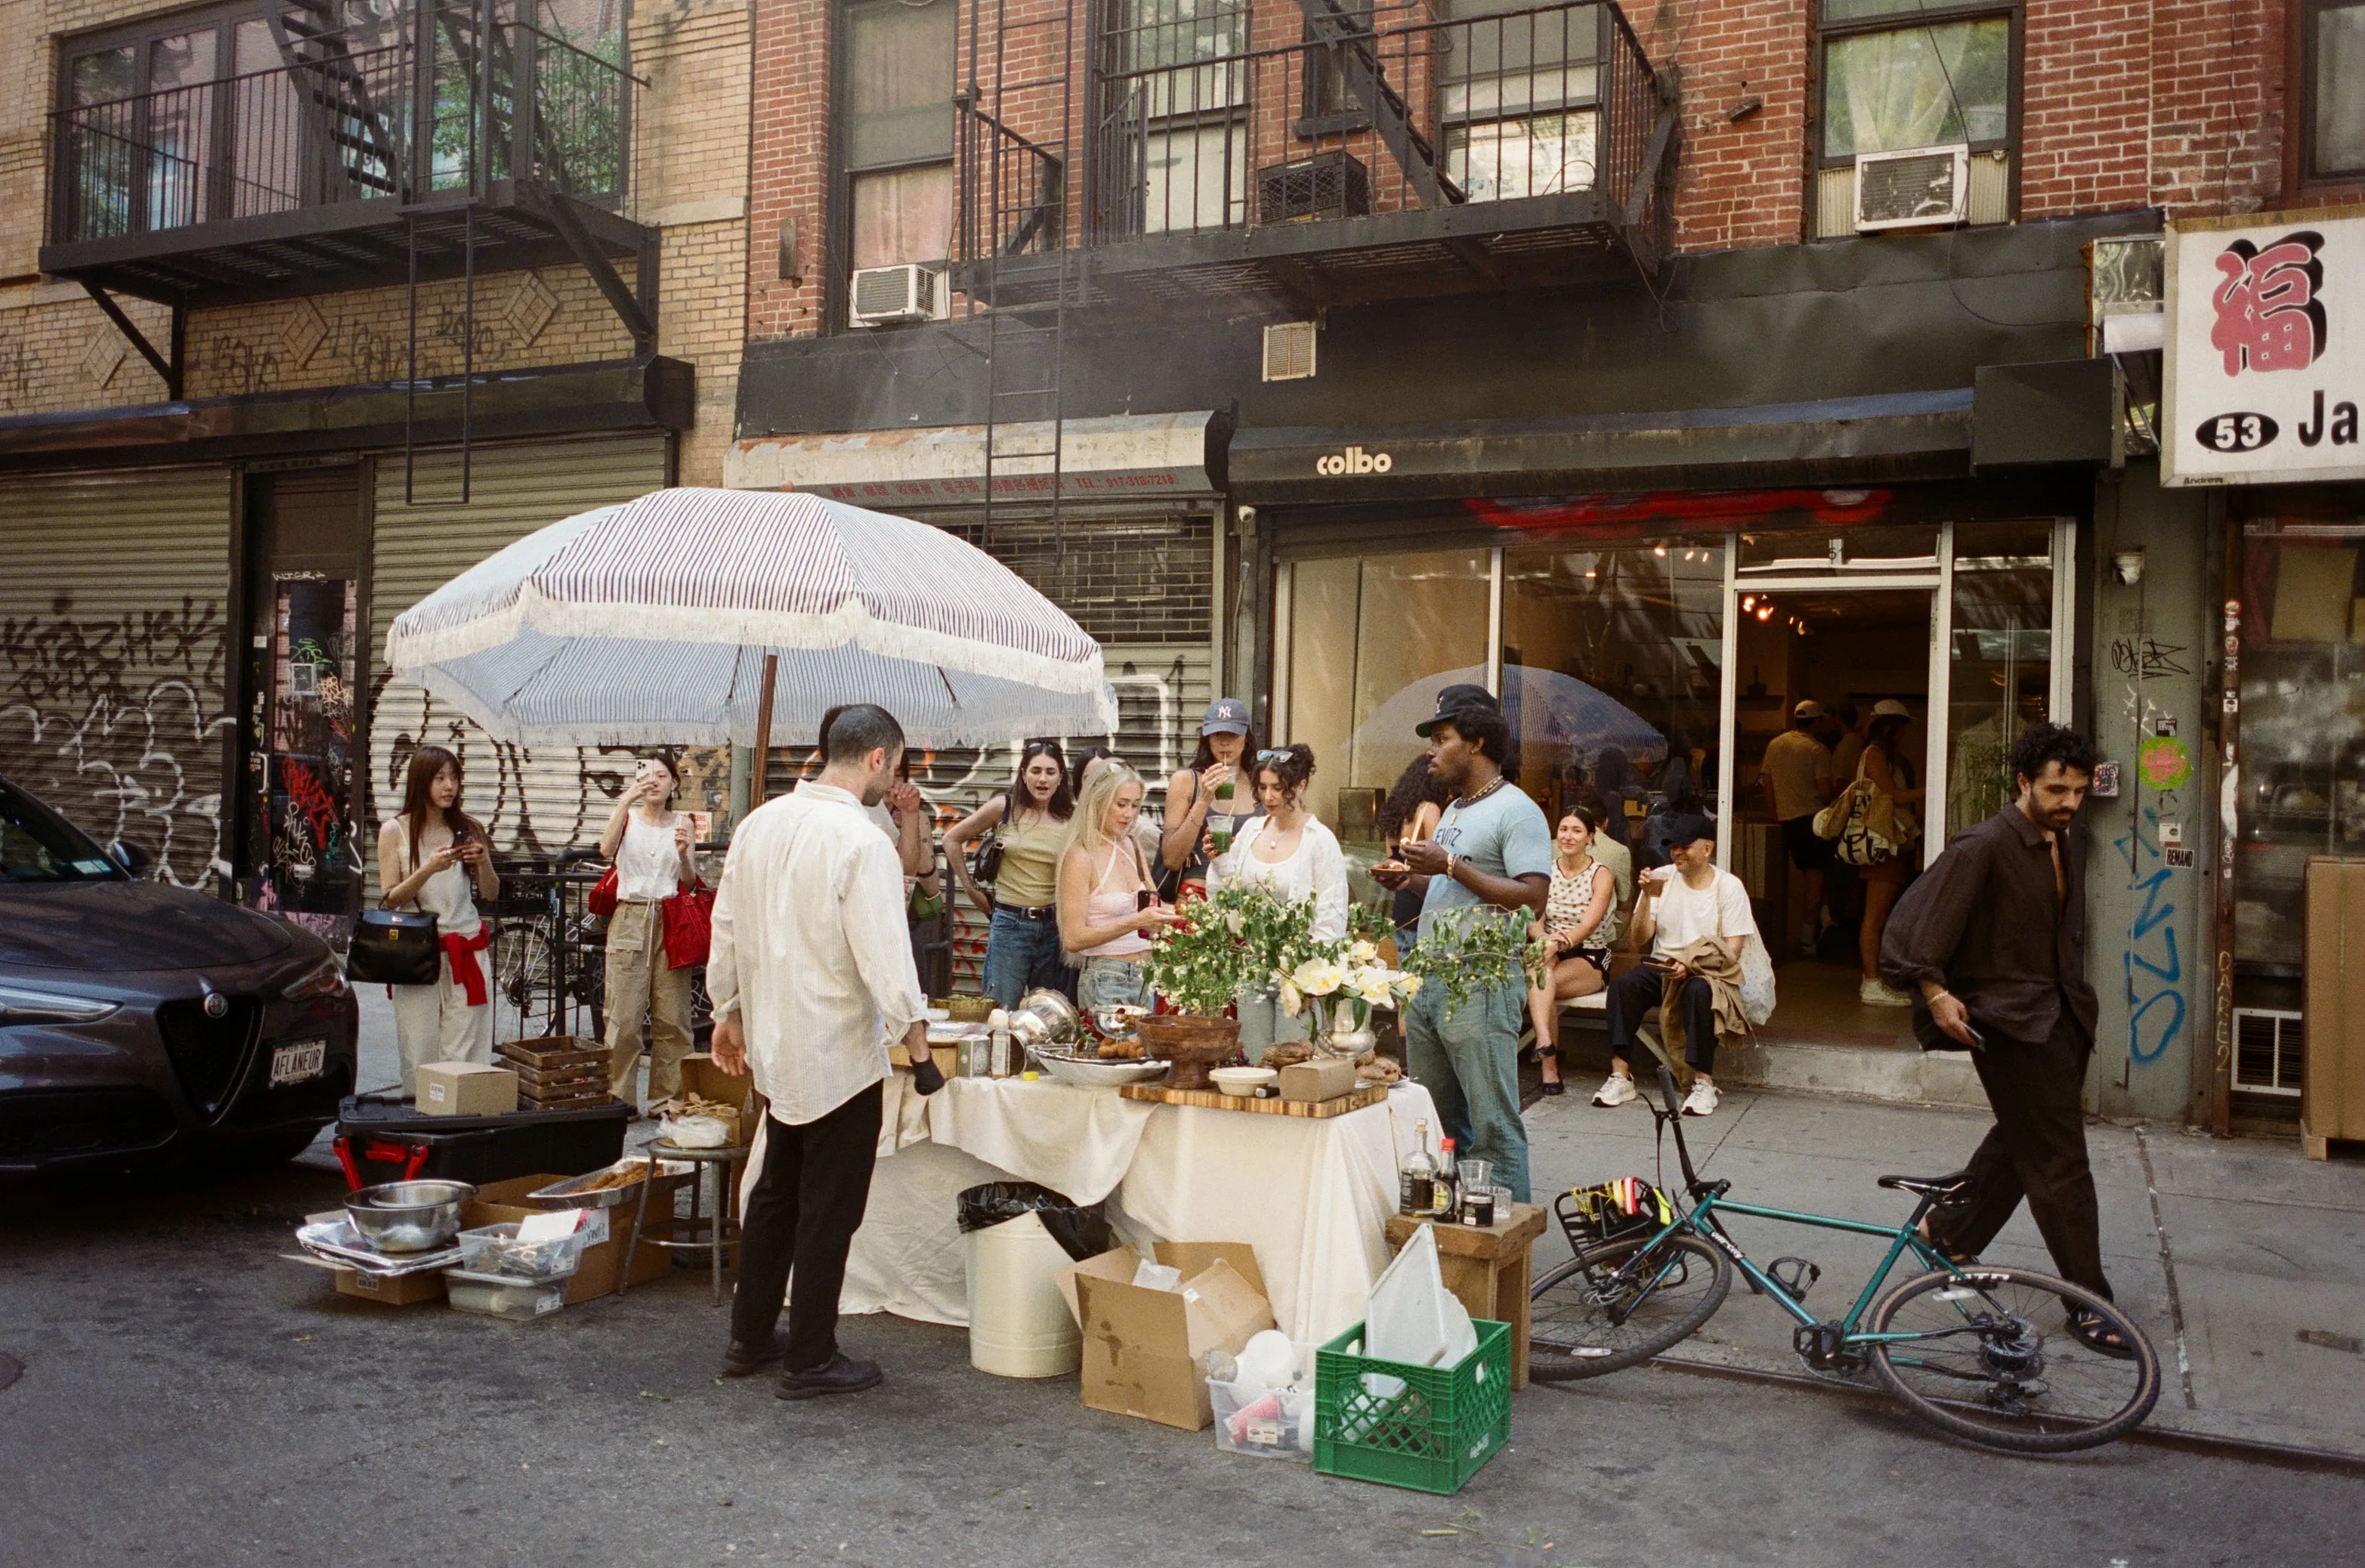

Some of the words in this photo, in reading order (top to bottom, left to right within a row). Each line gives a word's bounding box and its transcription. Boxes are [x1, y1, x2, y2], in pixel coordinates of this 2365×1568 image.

[2211, 230, 2327, 377] 福
[2215, 416, 2262, 449] 53
[2299, 390, 2359, 447] Ja
[1317, 447, 1392, 475] colbo
[1218, 706, 1232, 719] NY
[2166, 848, 2194, 868] REMAND
[273, 1048, 321, 1078] AFLANEUR
